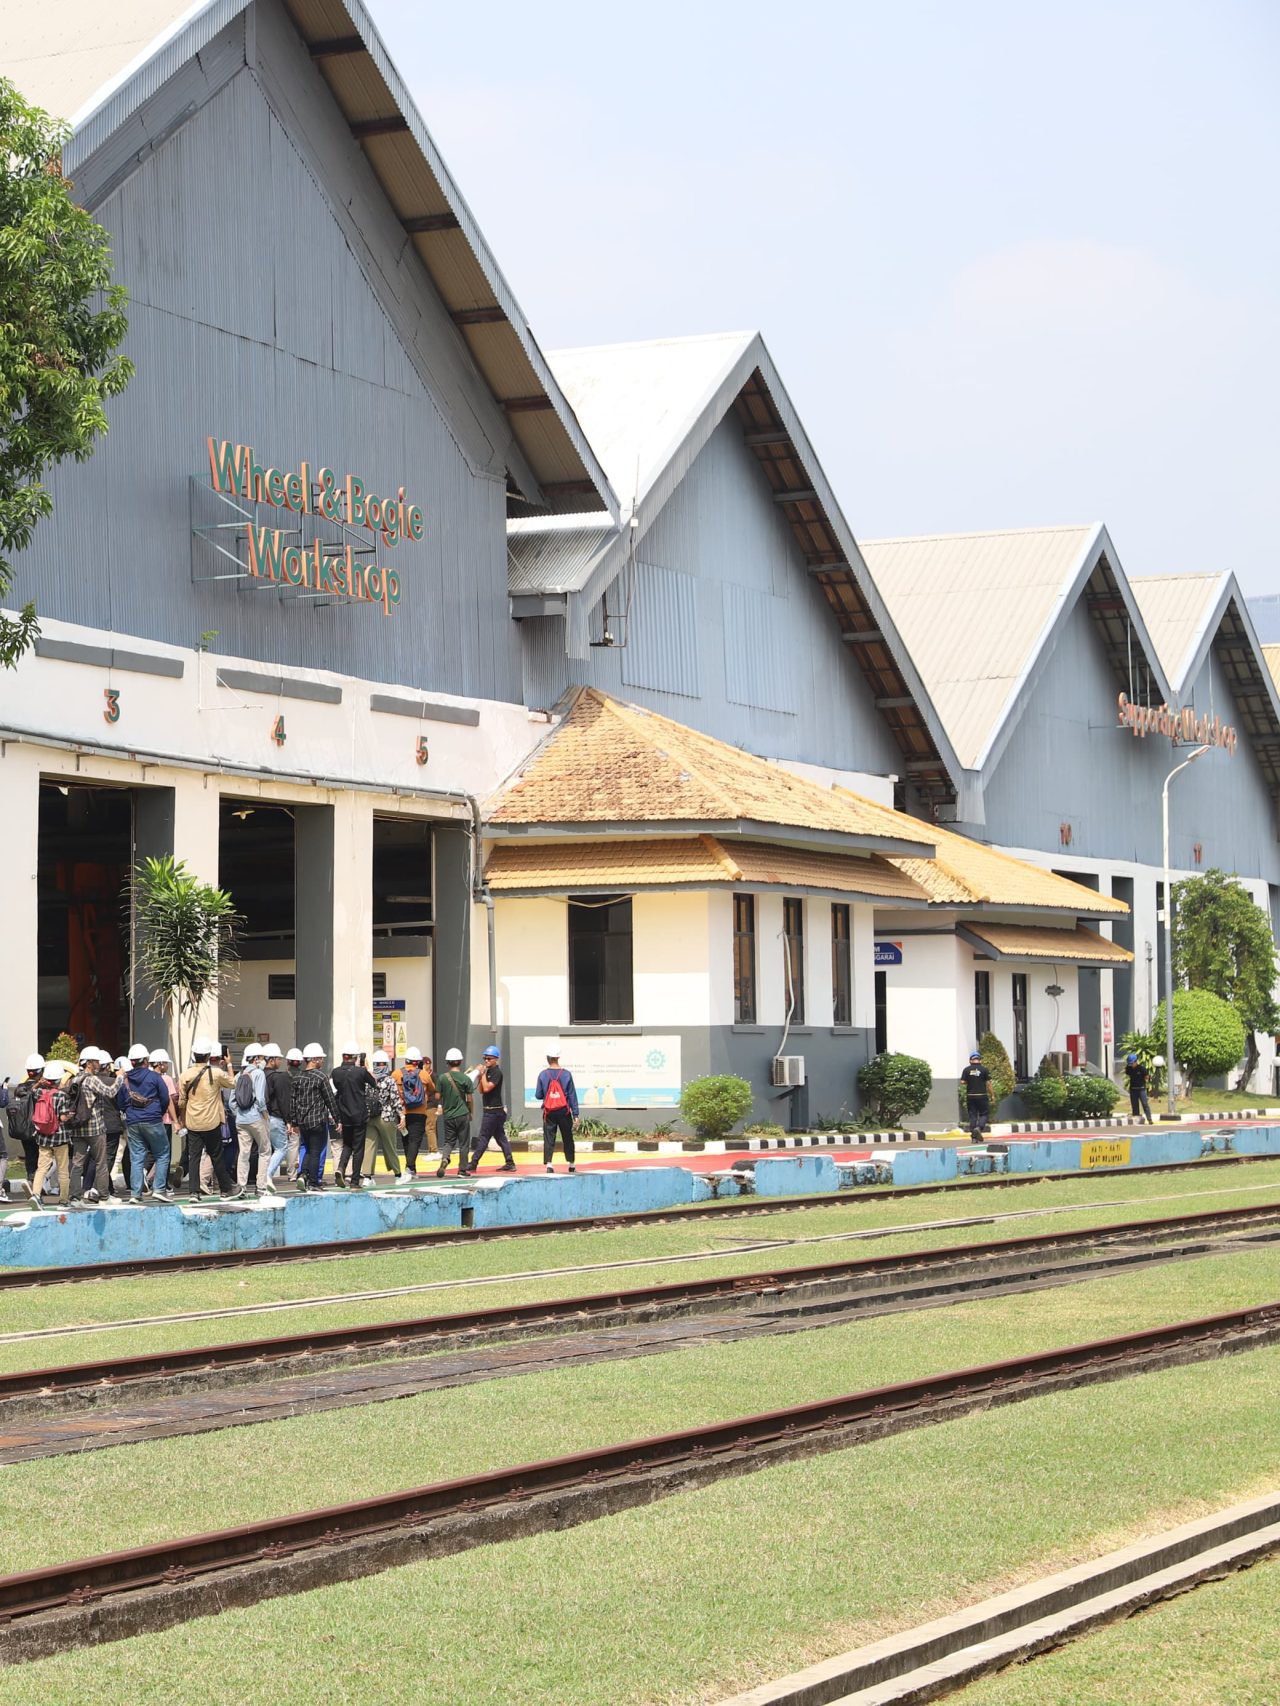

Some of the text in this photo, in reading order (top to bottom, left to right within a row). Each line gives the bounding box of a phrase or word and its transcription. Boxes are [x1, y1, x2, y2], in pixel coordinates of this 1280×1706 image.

[208, 436, 425, 548] Wheel & Bogie
[247, 522, 402, 616] Workshop
[103, 688, 120, 724] 3
[271, 715, 286, 746] 4
[416, 736, 428, 766] 5
